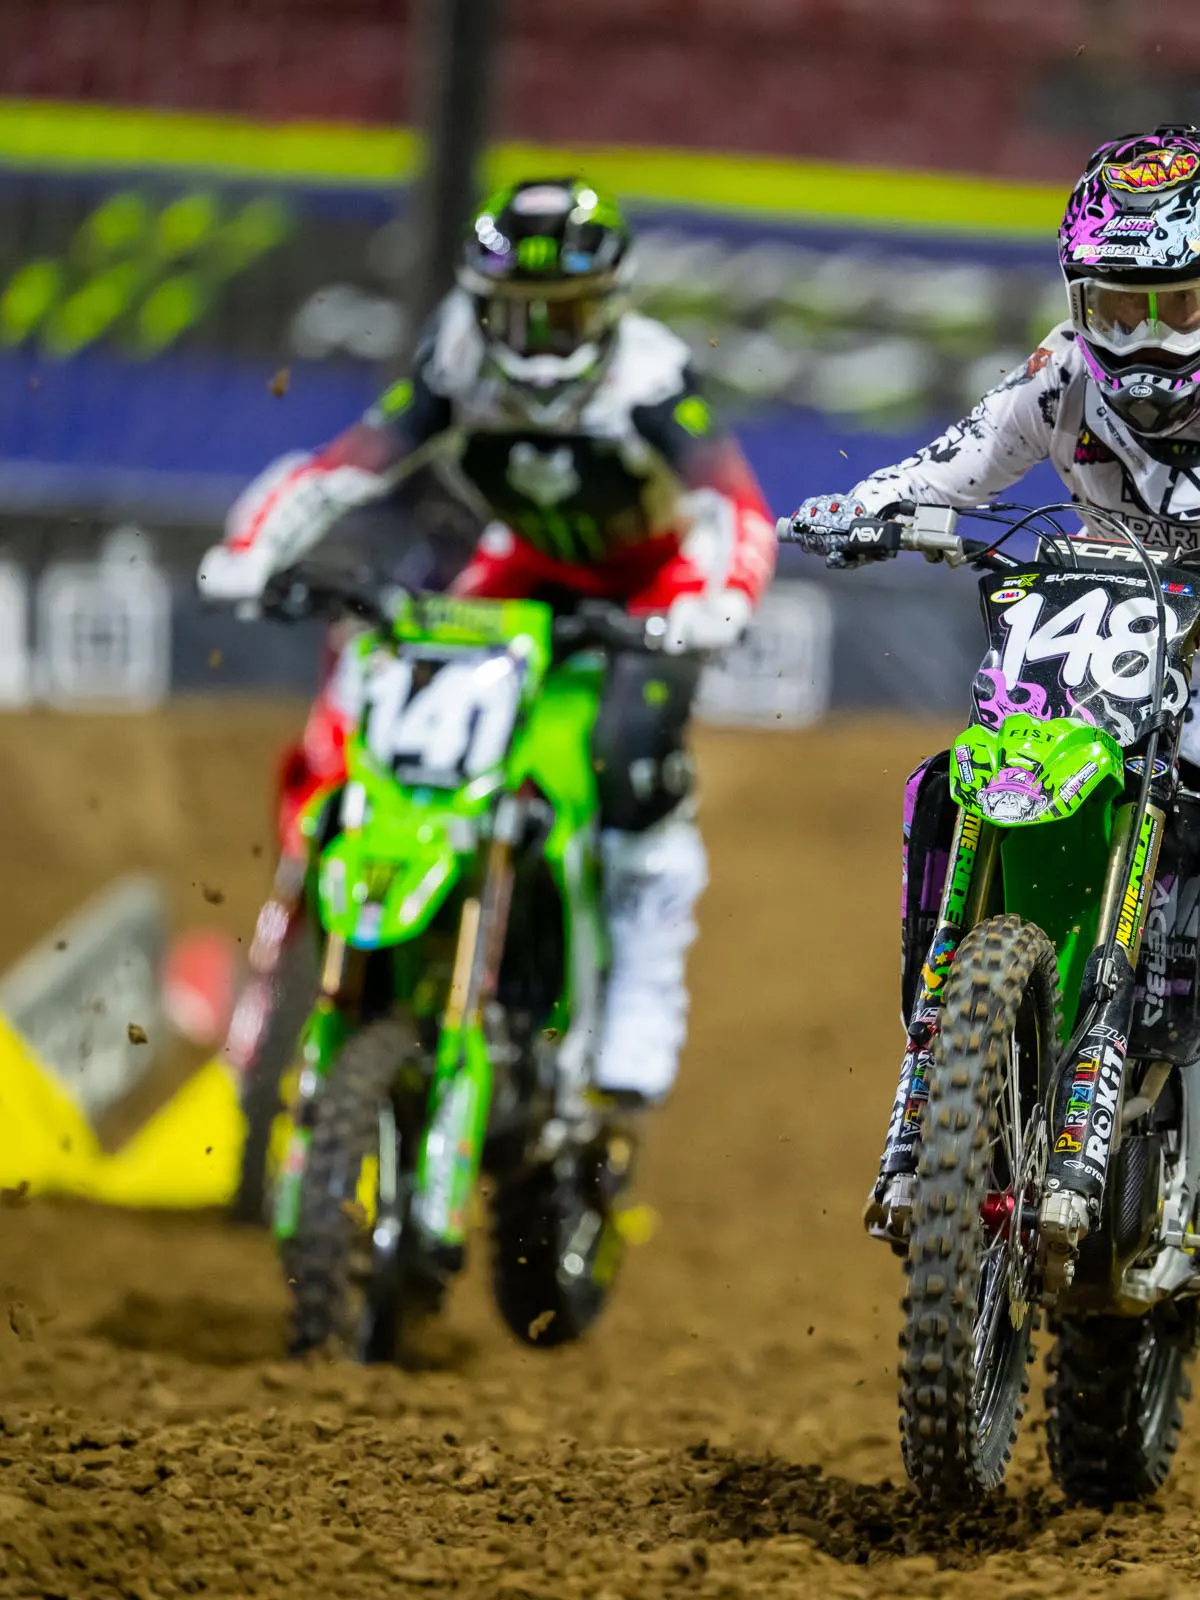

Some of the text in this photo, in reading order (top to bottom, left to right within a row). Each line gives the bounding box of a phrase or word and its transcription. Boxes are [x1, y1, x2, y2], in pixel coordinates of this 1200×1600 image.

[1103, 215, 1156, 232] BLASTER
[1096, 230, 1150, 238] POWER
[1131, 384, 1152, 396] Arai
[849, 526, 884, 543] ASV
[1044, 573, 1148, 588] SUPERCROSS
[1000, 587, 1180, 701] 148
[1009, 728, 1055, 742] FIST
[1054, 1044, 1103, 1153] PARTZILLA
